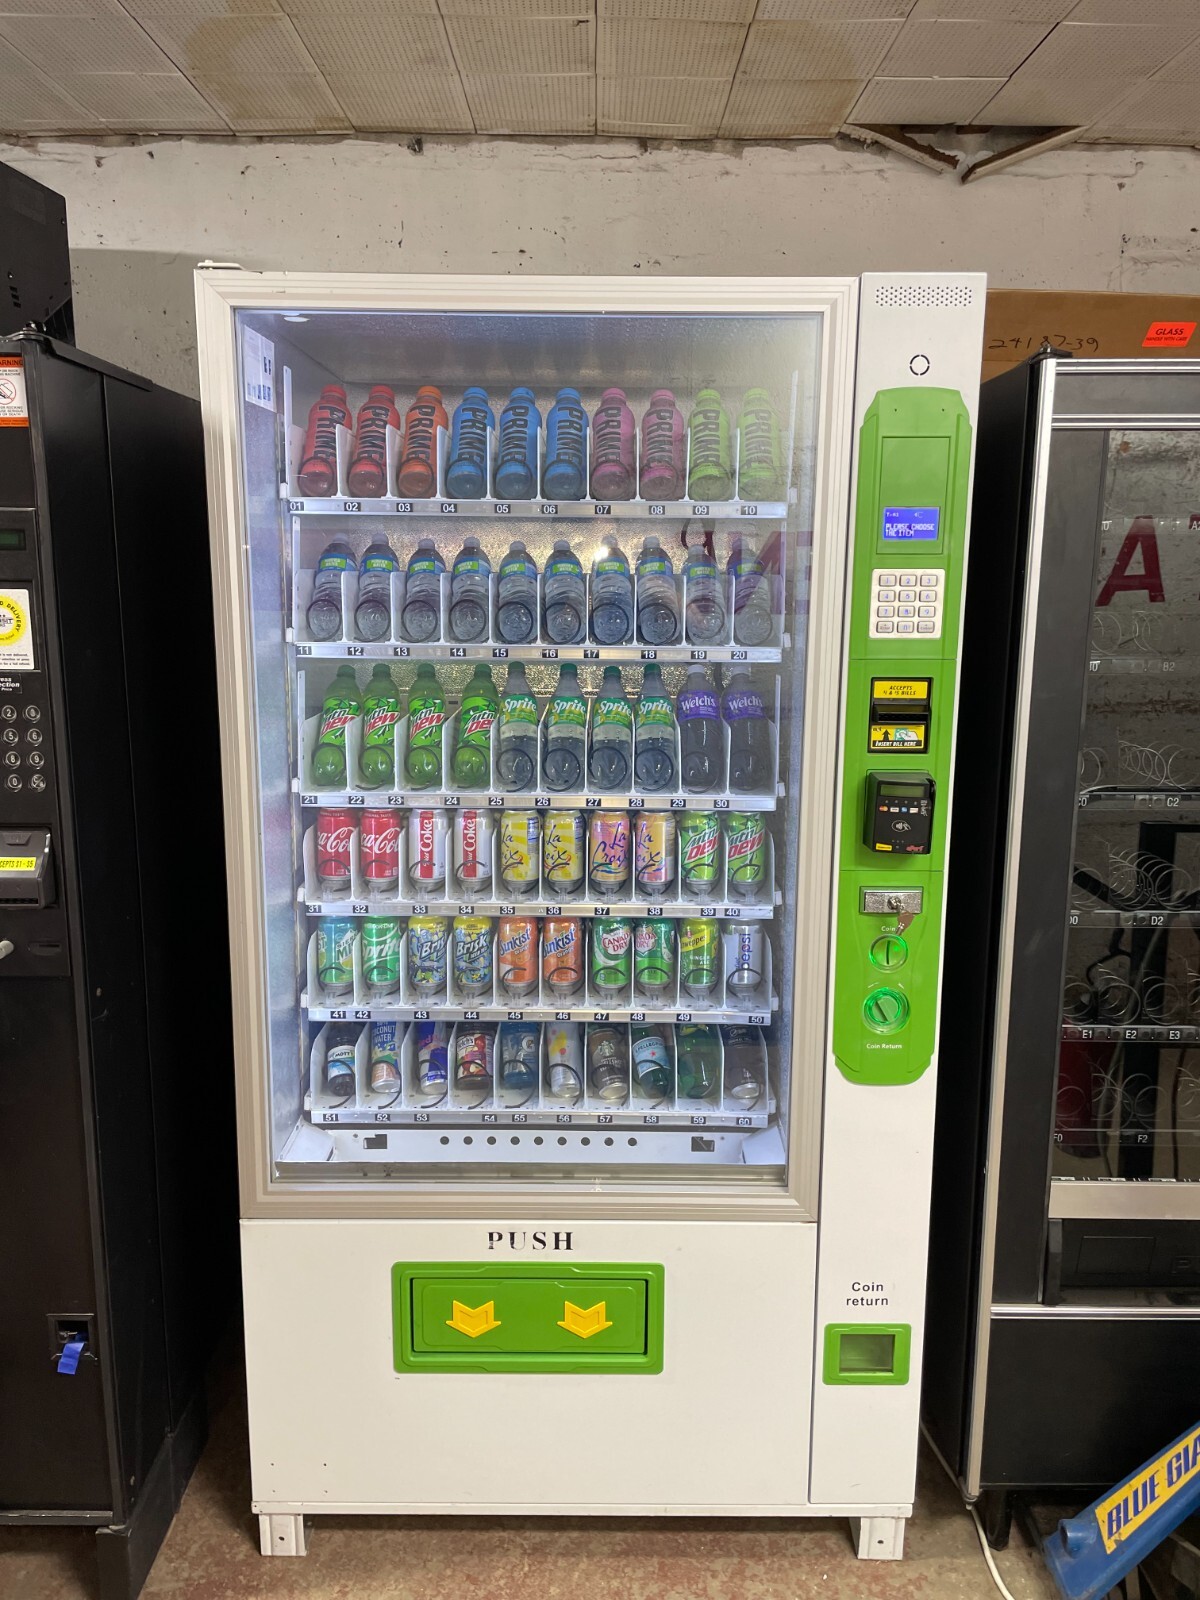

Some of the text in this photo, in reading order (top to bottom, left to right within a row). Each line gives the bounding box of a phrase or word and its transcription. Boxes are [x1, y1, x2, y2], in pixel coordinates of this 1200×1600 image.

[1155, 328, 1185, 336] GLASS
[556, 406, 584, 465] PRIME
[290, 502, 301, 511] 01
[345, 502, 359, 511] 02
[398, 503, 411, 512] 03
[442, 504, 456, 513] 04
[496, 504, 509, 514] 05
[543, 505, 556, 514] 06
[596, 505, 609, 514] 07
[651, 506, 663, 515] 08
[695, 506, 707, 515] 09
[744, 506, 756, 515] 10
[885, 523, 935, 531] PLEASE CHOOSE
[1095, 514, 1166, 607] A
[298, 646, 309, 655] 11
[349, 647, 362, 656] 12
[395, 648, 408, 656] 13
[452, 648, 464, 657] 14
[494, 648, 506, 657] 15
[544, 649, 556, 658] 16
[586, 649, 598, 658] 17
[643, 650, 655, 659] 18
[693, 651, 705, 659] 19
[733, 651, 745, 659] 20
[1162, 661, 1175, 672] B2
[503, 697, 537, 712] Sprite
[552, 699, 586, 714] Sprite
[639, 699, 673, 714] Sprite
[681, 695, 717, 711] Welch's
[728, 695, 763, 711] Welch's
[6, 708, 12, 717] 2
[599, 700, 632, 717] Sprite
[8, 732, 14, 740] 5
[32, 732, 37, 740] 6
[10, 755, 16, 763] 8
[34, 755, 40, 763] 9
[12, 778, 18, 786] 0
[304, 796, 315, 804] 21
[350, 796, 363, 804] 22
[389, 796, 402, 804] 23
[446, 797, 458, 805] 24
[490, 797, 503, 805] 25
[536, 798, 549, 806] 26
[587, 798, 600, 806] 27
[630, 799, 643, 807] 28
[672, 799, 684, 807] 29
[715, 800, 728, 808] 30
[1166, 797, 1179, 807] C2
[419, 818, 433, 852] Coke
[463, 818, 476, 852] Coke
[546, 824, 562, 848] La
[609, 822, 627, 849] La
[637, 822, 653, 849] La
[308, 905, 319, 913] 31
[354, 905, 367, 913] 32
[414, 905, 426, 914] 33
[460, 906, 472, 914] 34
[501, 906, 514, 914] 35
[547, 906, 560, 914] 36
[596, 907, 608, 915] 37
[649, 907, 661, 915] 38
[702, 908, 714, 916] 39
[726, 908, 738, 916] 40
[1151, 916, 1164, 925] D2
[456, 935, 487, 956] Brisk
[612, 940, 628, 952] DRY
[332, 1010, 344, 1018] 41
[356, 1011, 369, 1019] 42
[415, 1011, 428, 1019] 43
[465, 1011, 478, 1019] 44
[509, 1011, 521, 1019] 45
[556, 1012, 569, 1020] 46
[631, 1013, 644, 1021] 48
[678, 1013, 690, 1021] 49
[751, 1016, 763, 1024] 50
[1082, 1030, 1093, 1038] E1
[1125, 1030, 1137, 1038] E2
[1169, 1031, 1180, 1039] E3
[416, 1114, 428, 1122] 53
[513, 1114, 526, 1122] 55
[599, 1115, 611, 1123] 57
[646, 1116, 657, 1124] 58
[1137, 1134, 1148, 1143] F2
[487, 1230, 575, 1251] PUSH
[851, 1281, 884, 1292] Coin
[846, 1296, 889, 1306] return
[1106, 1469, 1160, 1540] BLUE
